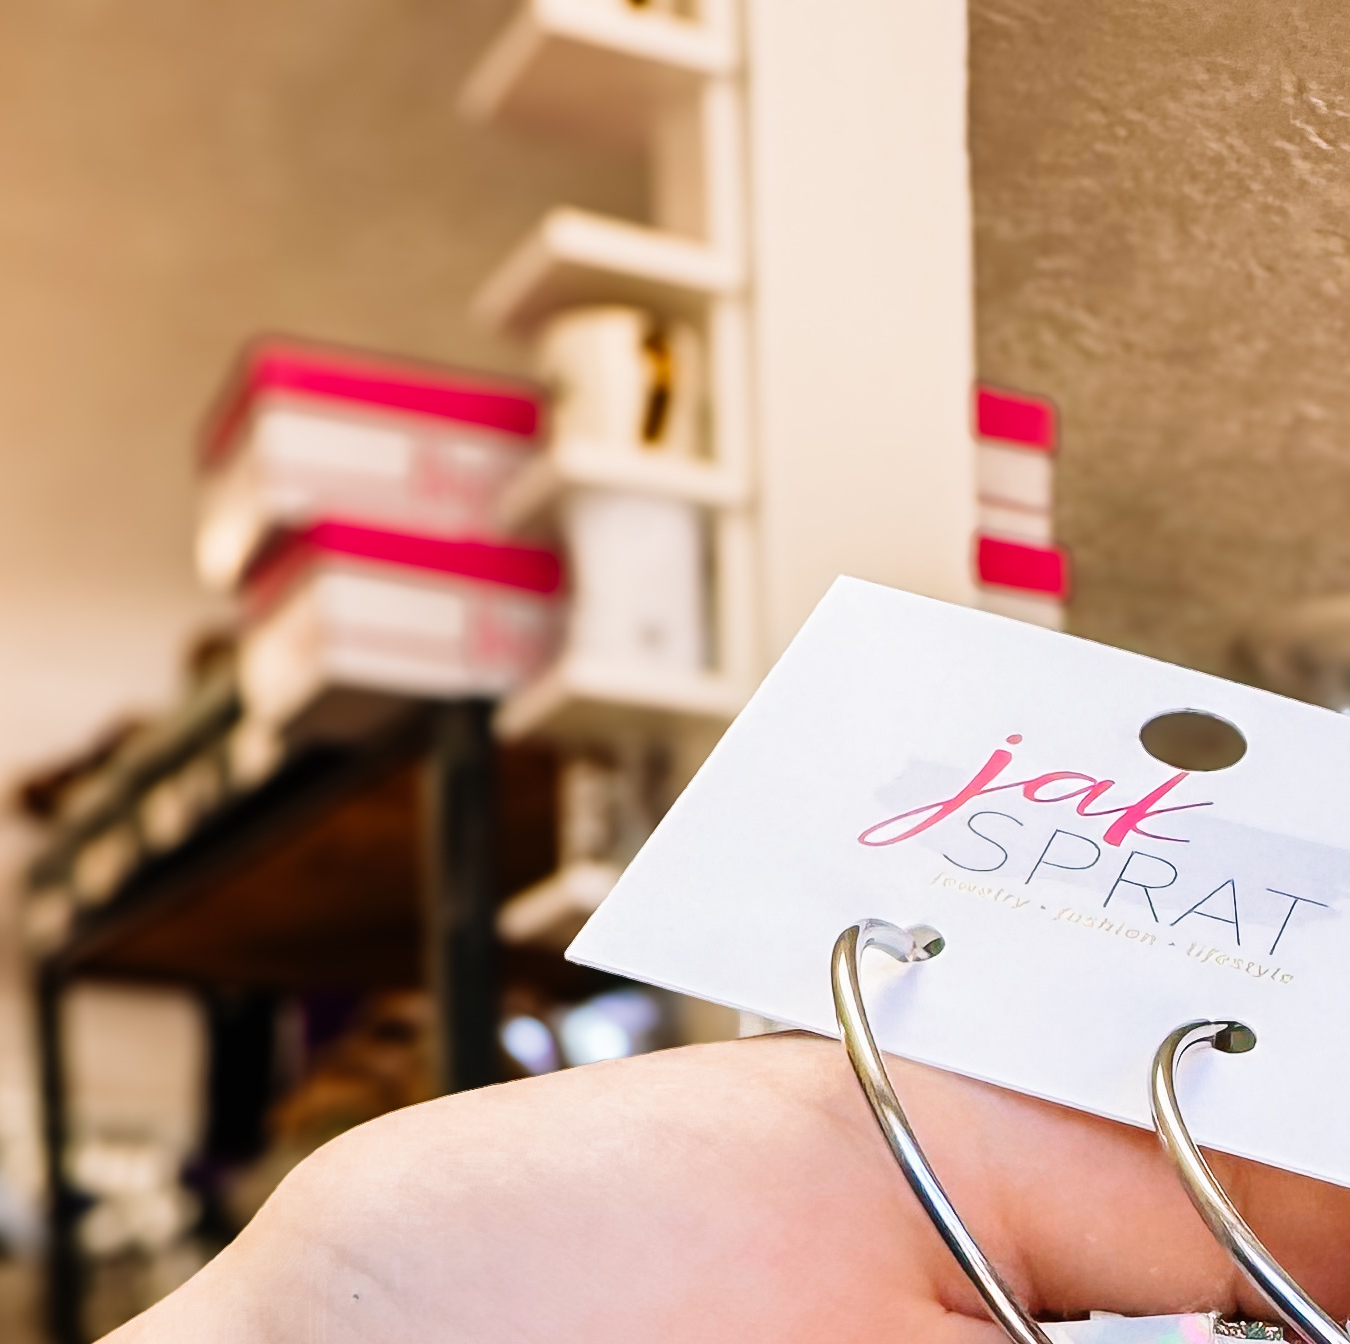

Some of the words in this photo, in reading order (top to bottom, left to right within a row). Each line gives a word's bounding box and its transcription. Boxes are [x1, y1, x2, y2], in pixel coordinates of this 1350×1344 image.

[857, 734, 1213, 847] jak
[942, 811, 1329, 956] SPRAT
[1052, 906, 1157, 946] fashion
[1186, 941, 1295, 985] lifestyle
